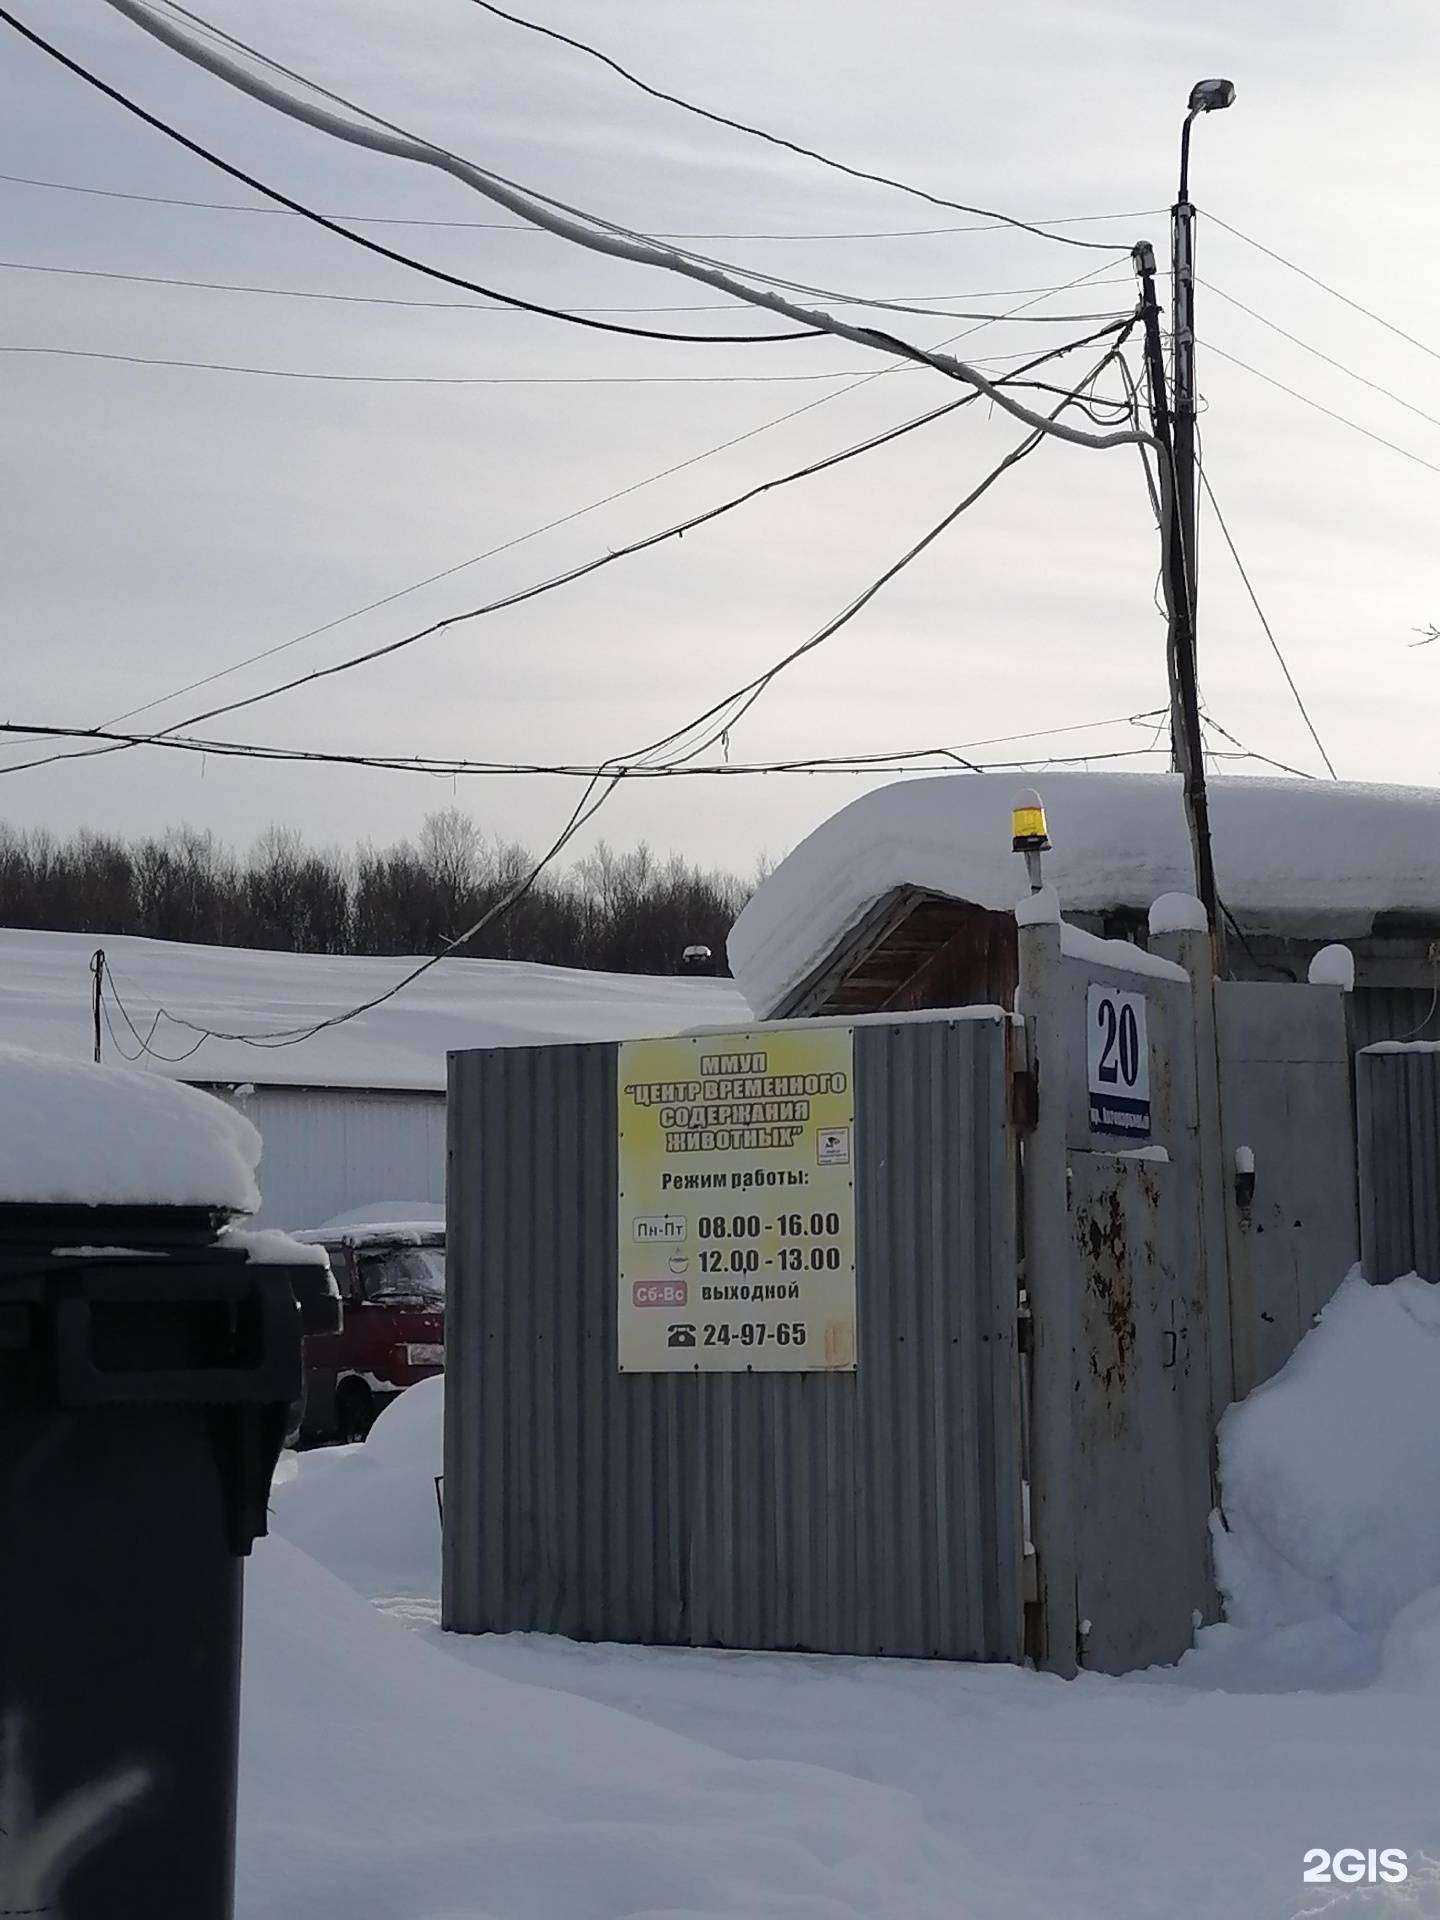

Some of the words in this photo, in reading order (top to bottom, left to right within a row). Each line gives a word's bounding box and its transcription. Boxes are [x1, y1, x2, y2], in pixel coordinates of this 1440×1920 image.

[1098, 999, 1139, 1087] 20
[701, 1052, 767, 1076] ММУП
[703, 1072, 846, 1100] ВРЕМЕННОГО
[660, 1100, 810, 1129] СОДЕРЖАНИЯ
[662, 1172, 728, 1190] Режим
[732, 1169, 808, 1190] работы:
[637, 1222, 684, 1237] Пн-Пт
[699, 1215, 760, 1238] 08.00
[777, 1213, 840, 1236] 16.00
[699, 1250, 759, 1273] 12.00
[777, 1247, 840, 1271] 13.00
[637, 1287, 684, 1301] Сб-Вс
[701, 1280, 799, 1301] выходной
[703, 1323, 806, 1346] 24-97-65
